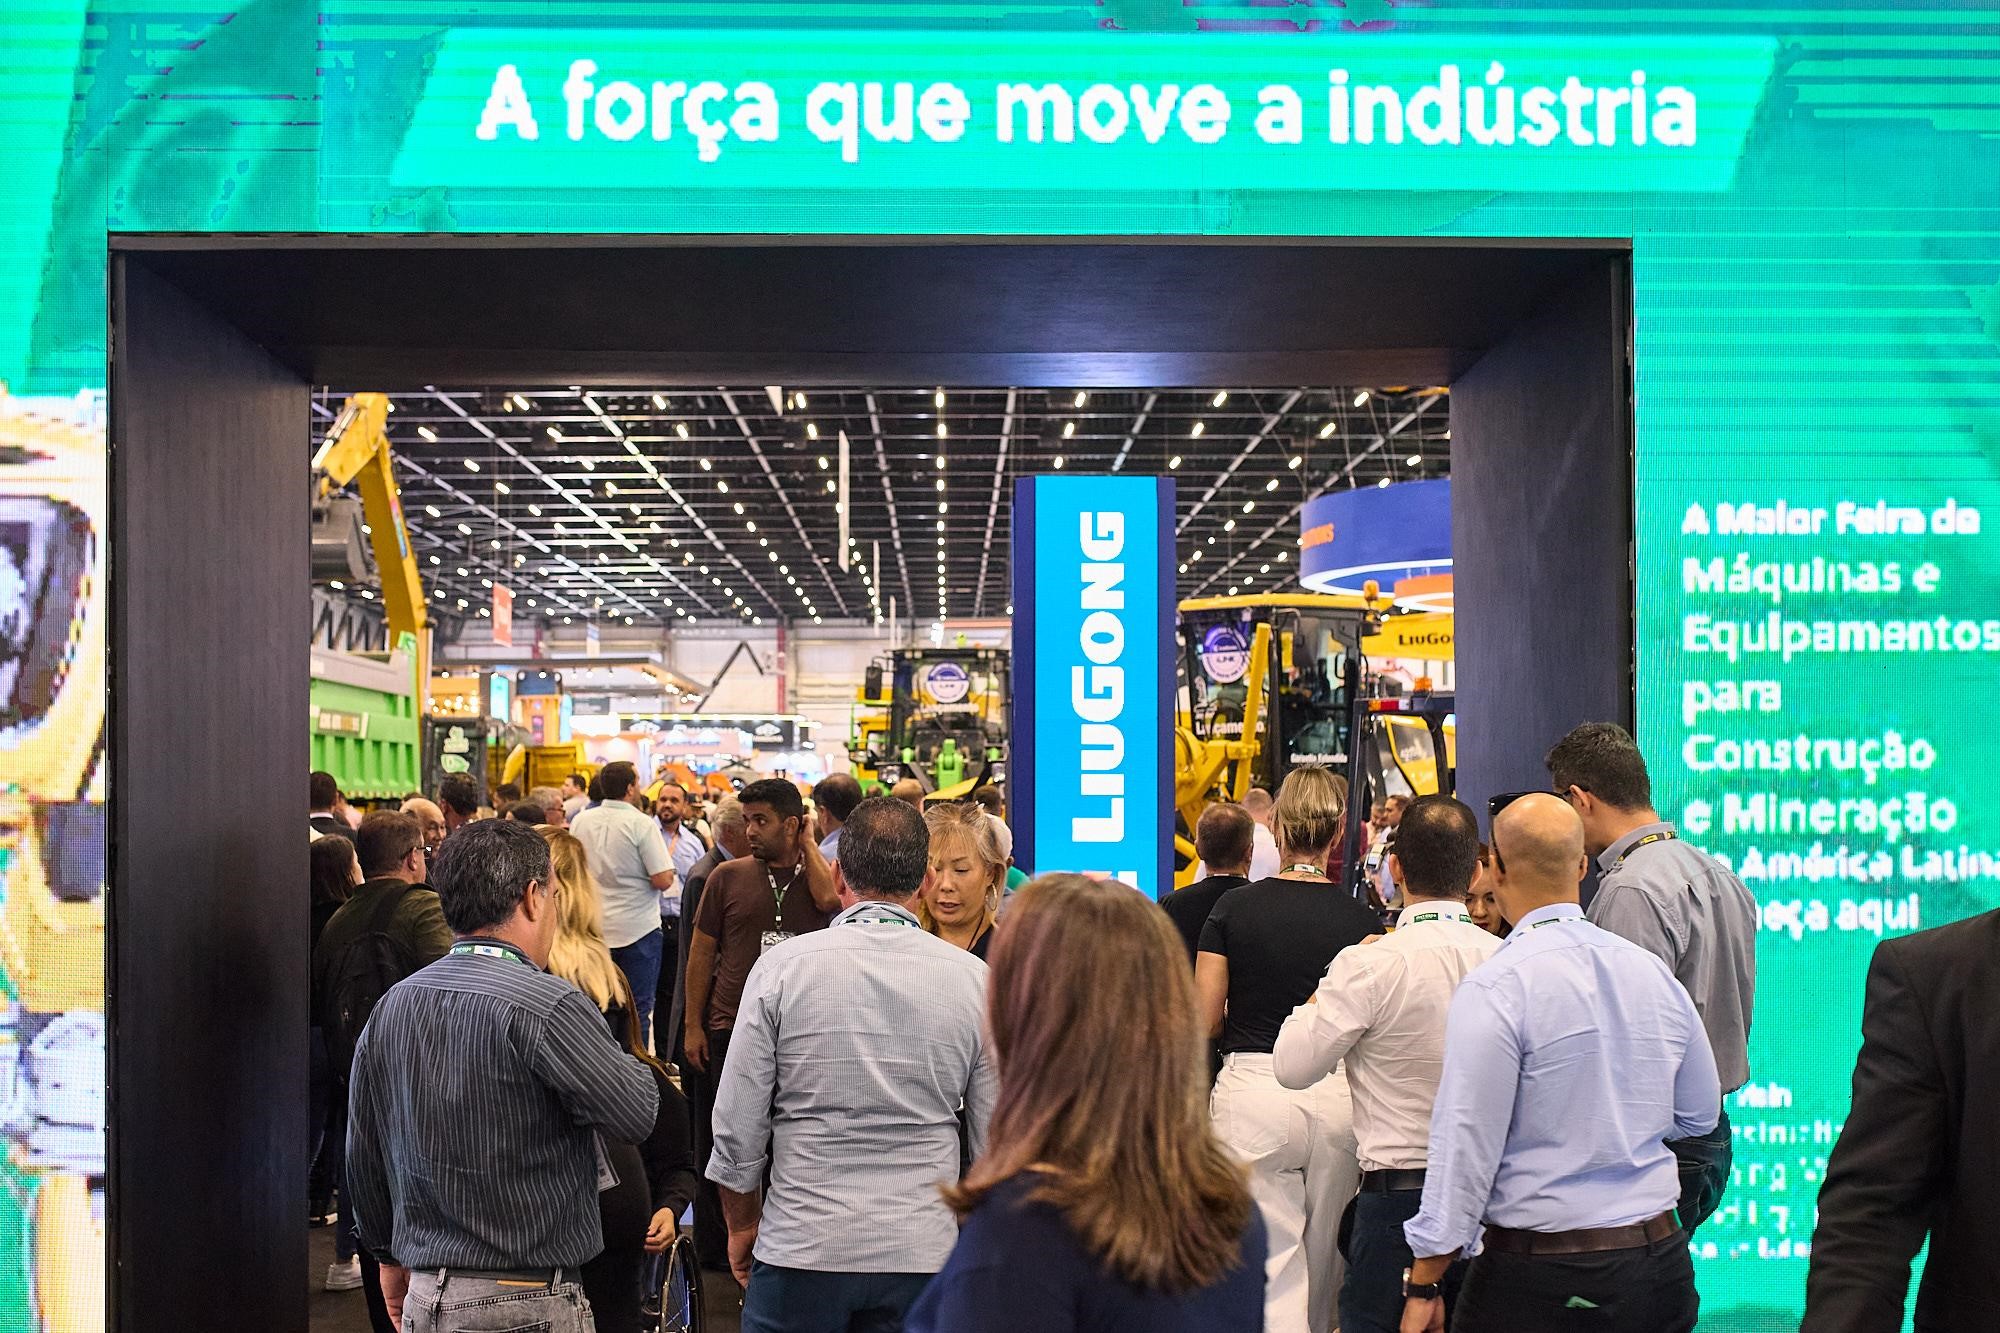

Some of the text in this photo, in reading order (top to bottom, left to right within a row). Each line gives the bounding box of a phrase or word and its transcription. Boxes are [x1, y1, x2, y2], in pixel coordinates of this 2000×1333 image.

[476, 59, 1697, 162] A força que move a indústria
[1682, 501, 1710, 535] A
[1716, 499, 1828, 535] Maior
[1836, 499, 1926, 535] Feira
[1682, 552, 1941, 604] Máquinas e
[1683, 611, 2000, 663] Equipamentos
[1683, 680, 1782, 727] para
[1683, 730, 1937, 784] Construção
[1684, 792, 1958, 844] e Mineração
[1738, 841, 1894, 882] América
[1835, 892, 1920, 936] aqui
